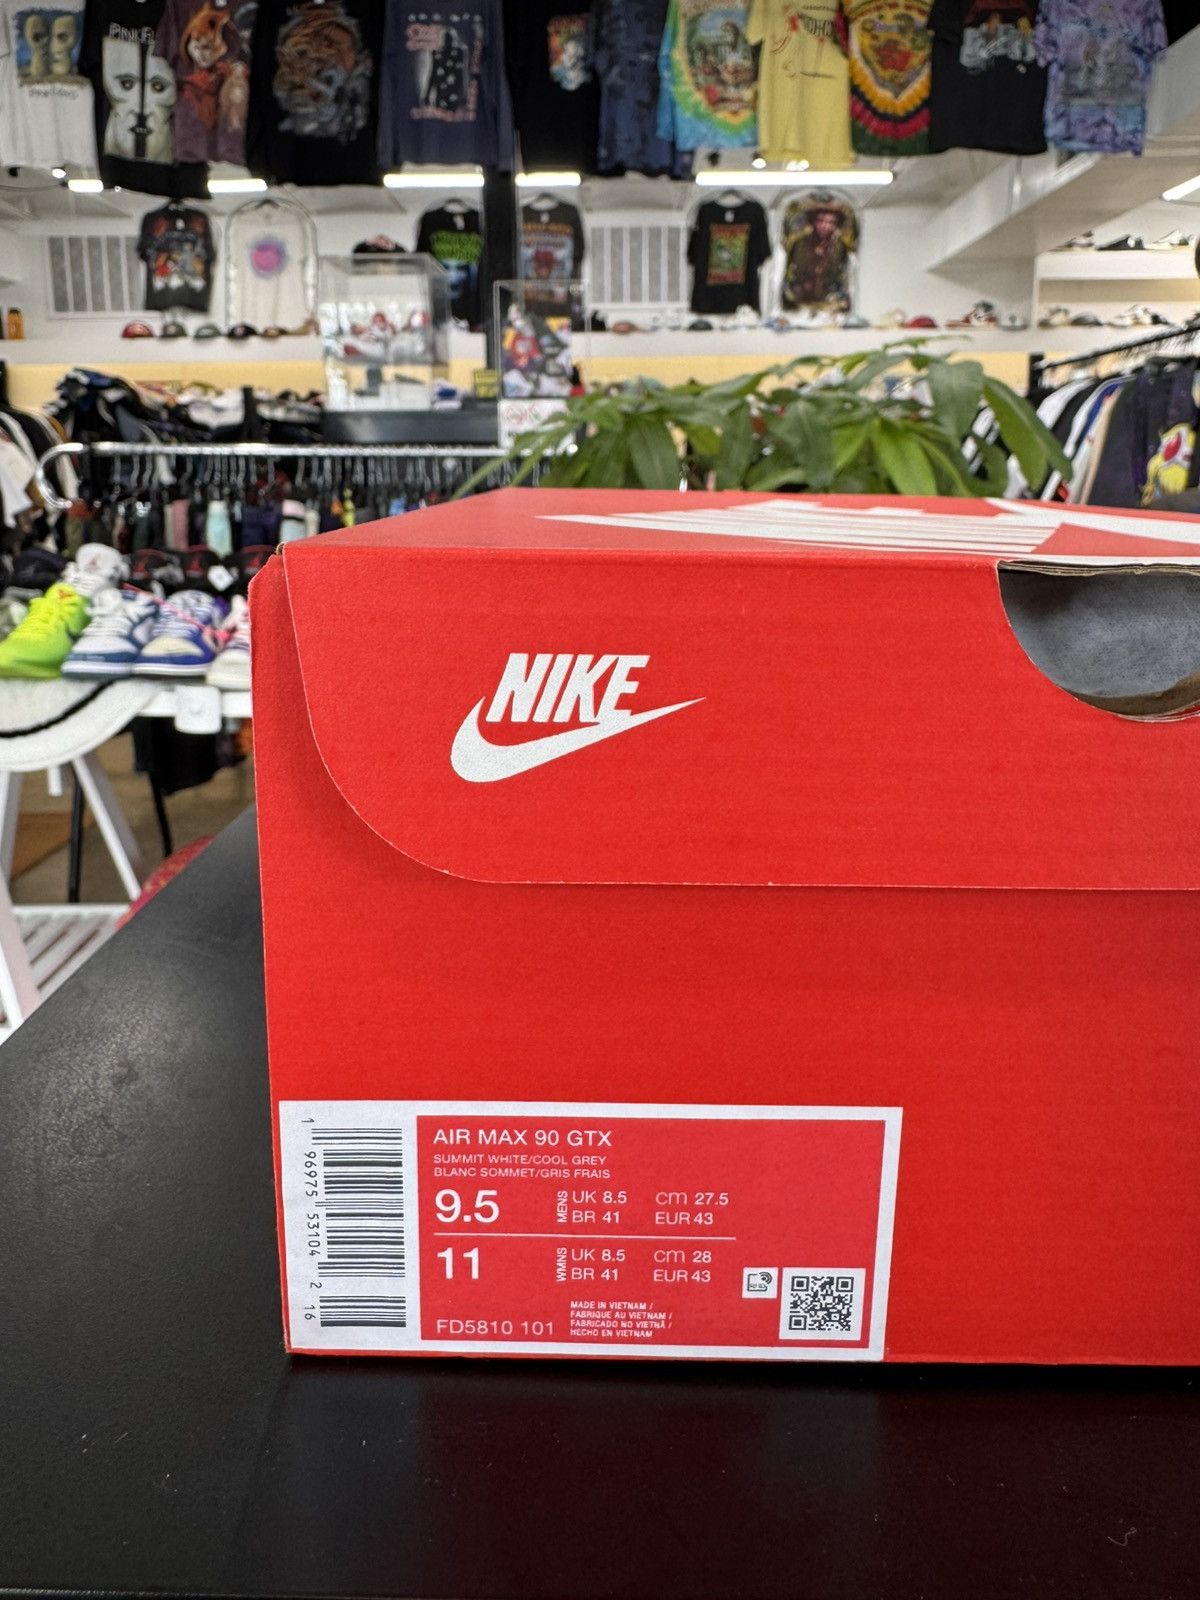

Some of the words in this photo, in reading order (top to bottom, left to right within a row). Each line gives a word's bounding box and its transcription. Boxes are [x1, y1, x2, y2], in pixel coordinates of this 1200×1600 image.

[485, 652, 650, 723] NIKE
[433, 1129, 470, 1145] AIR
[478, 1129, 527, 1145] MAX
[535, 1130, 559, 1146] 90
[567, 1130, 612, 1147] GTX
[433, 1154, 484, 1164] SUMMIT
[489, 1155, 568, 1165] WHITE/COOL
[572, 1156, 607, 1166] GREY
[304, 1151, 318, 1197] 96975
[433, 1168, 477, 1177] BLANC
[480, 1168, 570, 1179] SOMMET/GRIS
[574, 1169, 611, 1179] FRAIS
[572, 1190, 597, 1204] UK
[603, 1191, 627, 1204] 8.5
[694, 1193, 729, 1206] 27.5
[435, 1188, 500, 1224] 9.5
[557, 1190, 568, 1223] MENS
[572, 1210, 596, 1223] BR
[602, 1211, 620, 1224] 41
[655, 1212, 691, 1225] EUR
[693, 1212, 714, 1225] 43
[307, 1213, 321, 1256] 53104
[571, 1248, 596, 1261] UK
[601, 1249, 626, 1262] 8.5
[692, 1250, 712, 1264] 28
[437, 1247, 480, 1280] 11
[556, 1247, 567, 1282] WMNS
[571, 1267, 595, 1280] BR
[601, 1268, 619, 1281] 41
[653, 1269, 688, 1282] EUR
[691, 1270, 711, 1283] 43
[570, 1301, 595, 1309] MADE
[609, 1302, 647, 1310] VIETNAM
[304, 1305, 317, 1321] 16
[570, 1310, 611, 1319] FABRIQUE
[614, 1311, 627, 1319] AU
[629, 1312, 666, 1320] VIETNAM
[436, 1319, 513, 1335] FD5810
[521, 1321, 554, 1336] 101
[570, 1320, 618, 1328] FABRICADO
[570, 1329, 599, 1337] HECHO
[616, 1330, 653, 1338] VIETNAM
